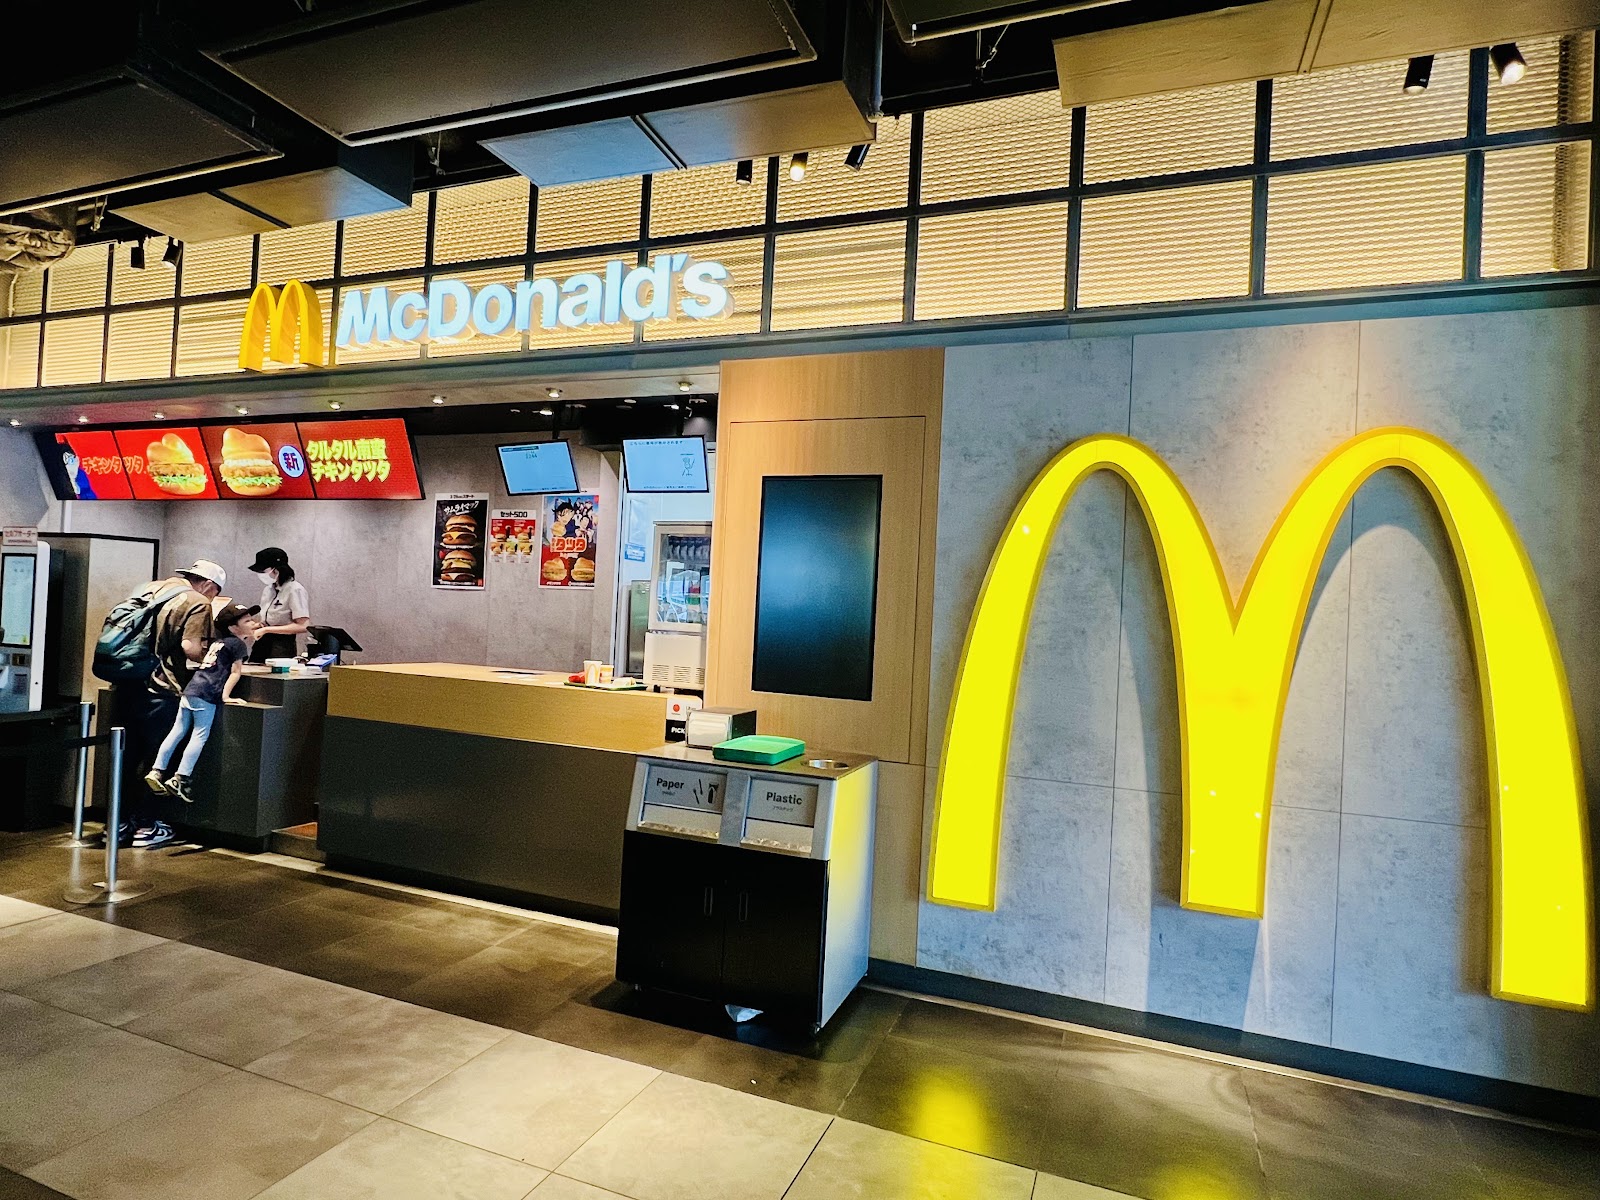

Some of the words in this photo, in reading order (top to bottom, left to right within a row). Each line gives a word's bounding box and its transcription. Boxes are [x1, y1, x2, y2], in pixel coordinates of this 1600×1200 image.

[336, 253, 730, 347] McDonald's
[306, 438, 388, 461] タルタル南蛮
[283, 453, 300, 471] 新
[311, 460, 391, 483] チキンタツタ
[656, 777, 685, 790] Paper
[766, 791, 804, 806] Plastic
